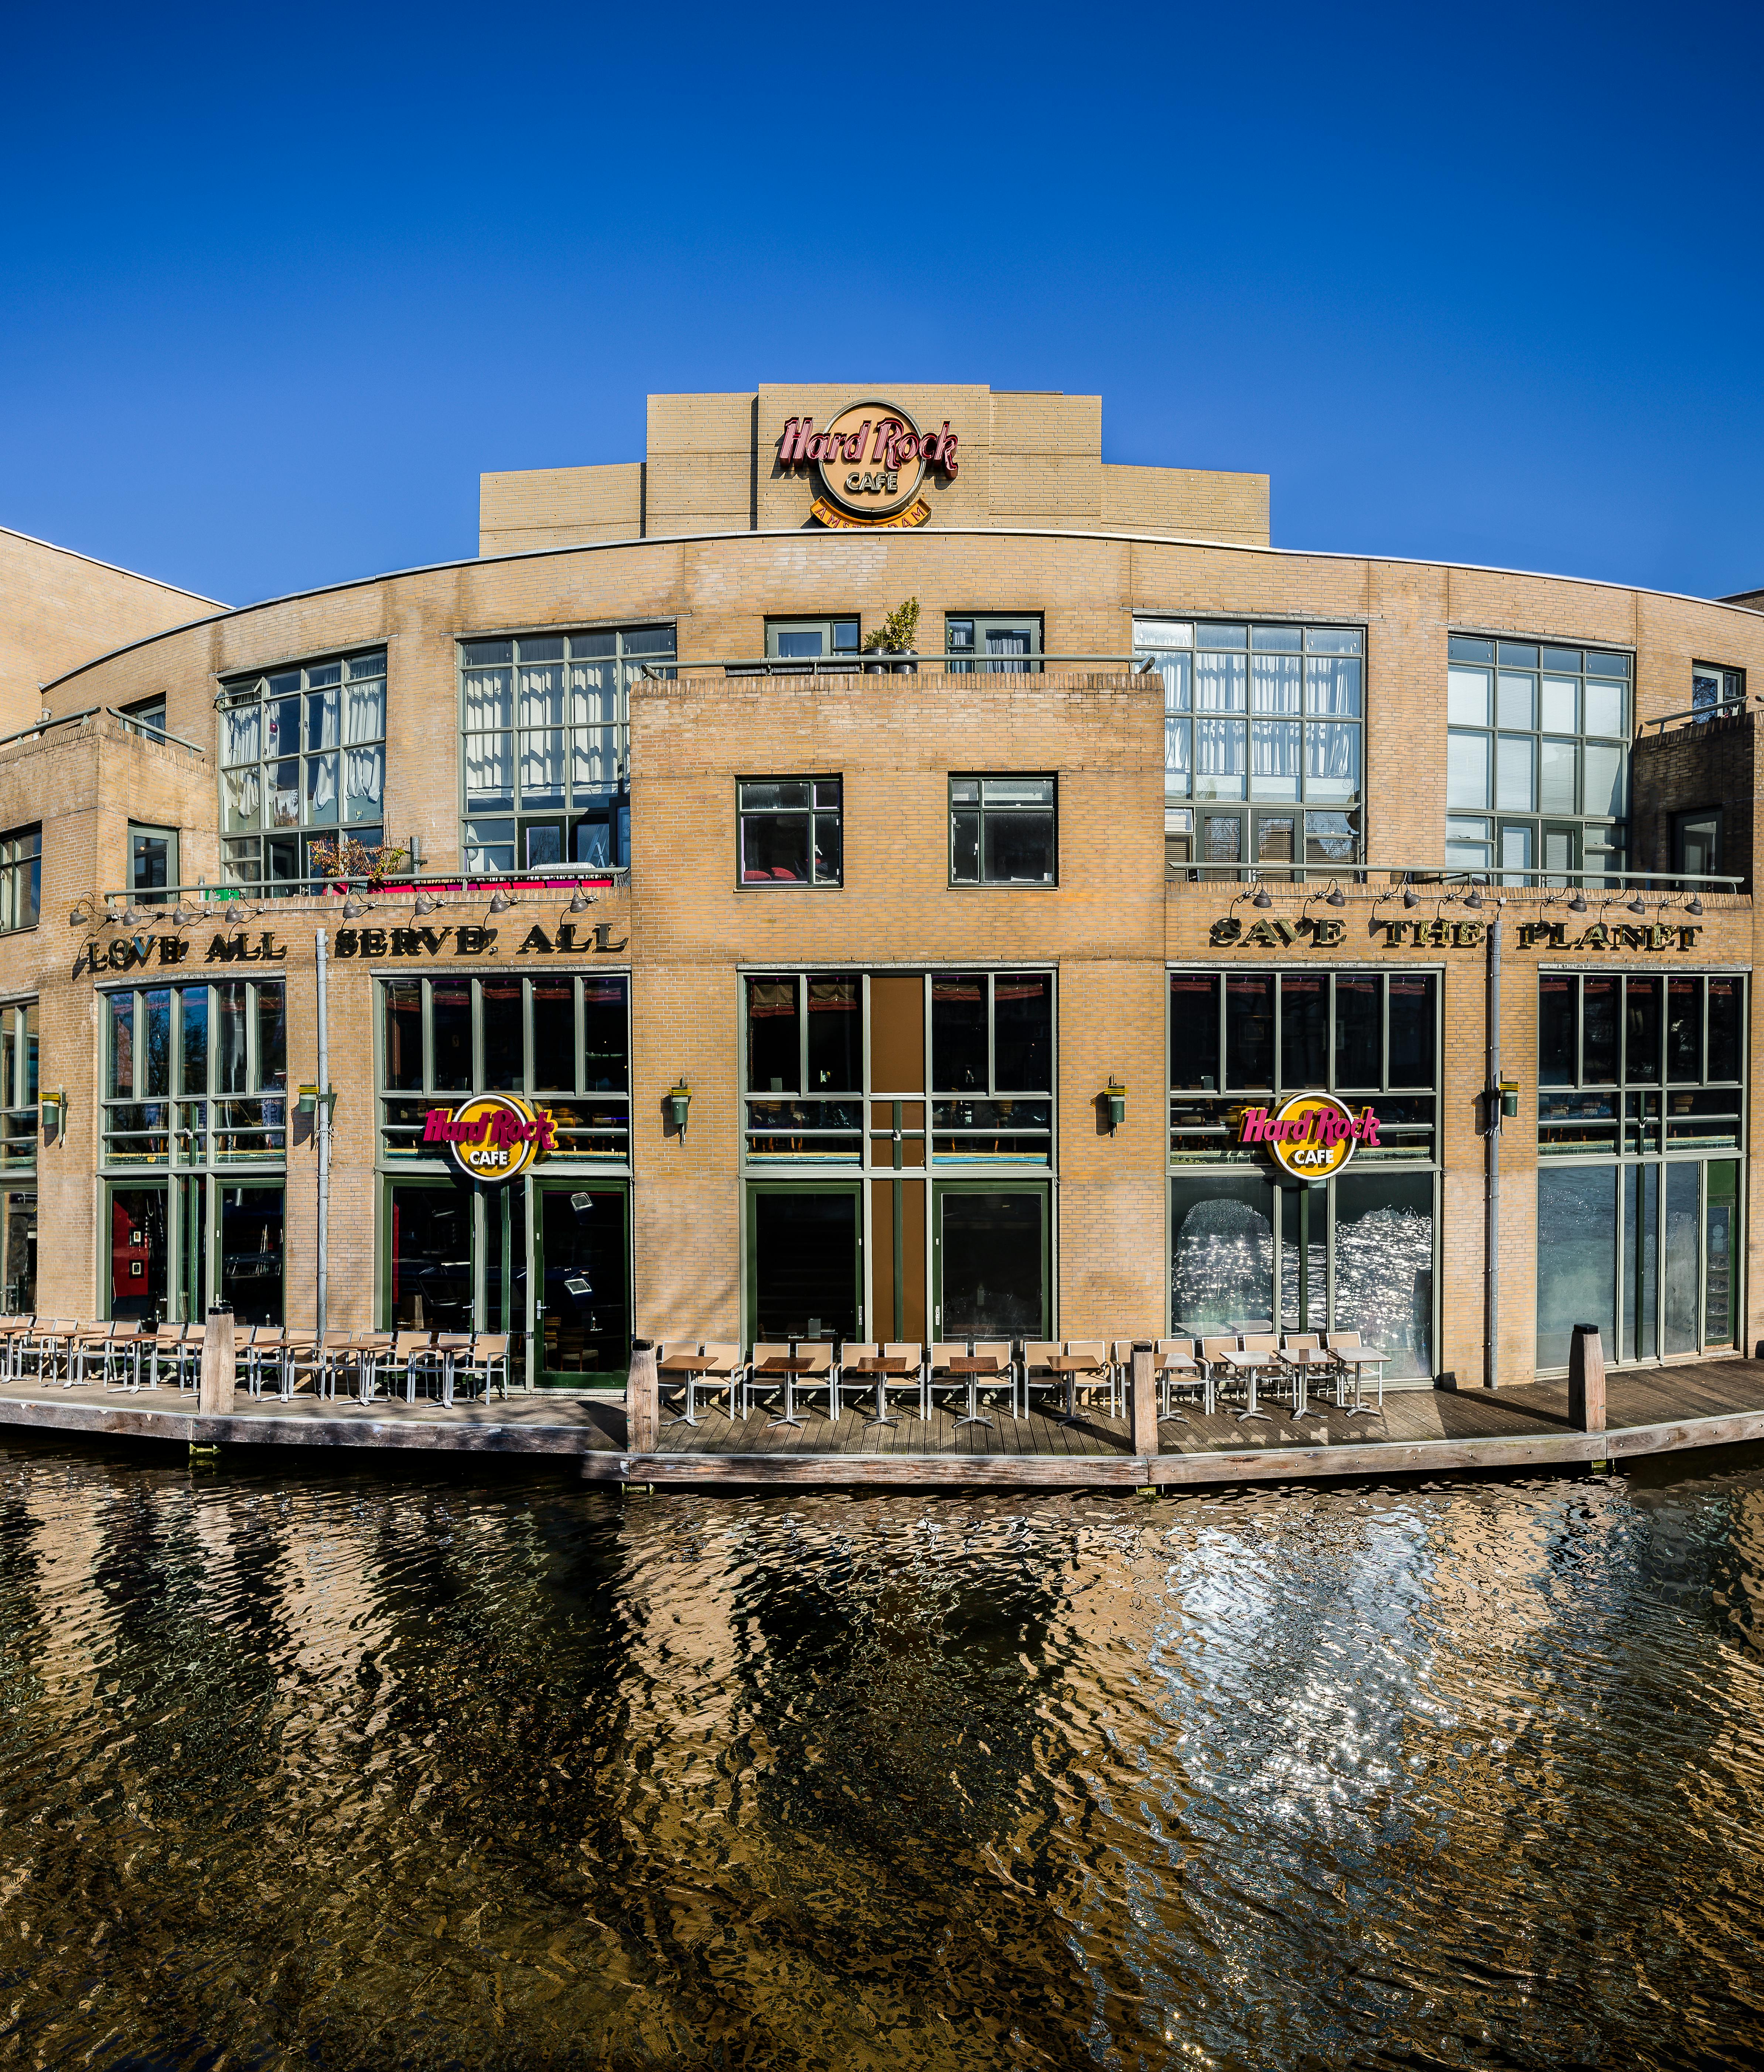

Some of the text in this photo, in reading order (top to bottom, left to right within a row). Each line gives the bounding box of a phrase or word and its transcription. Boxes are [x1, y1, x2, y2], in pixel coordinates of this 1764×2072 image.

[779, 417, 959, 475] Hard Rock
[846, 471, 898, 491] CAFE
[814, 506, 926, 528] AMSAM
[86, 923, 629, 971] LOVE ALL SERVE ALL
[1209, 918, 1704, 948] SAVE THE PLANET
[423, 1109, 556, 1149] Hard Rock
[1243, 1107, 1381, 1147] Hard Rock
[470, 1151, 508, 1165] CAFE
[1294, 1149, 1334, 1164] CAFE
